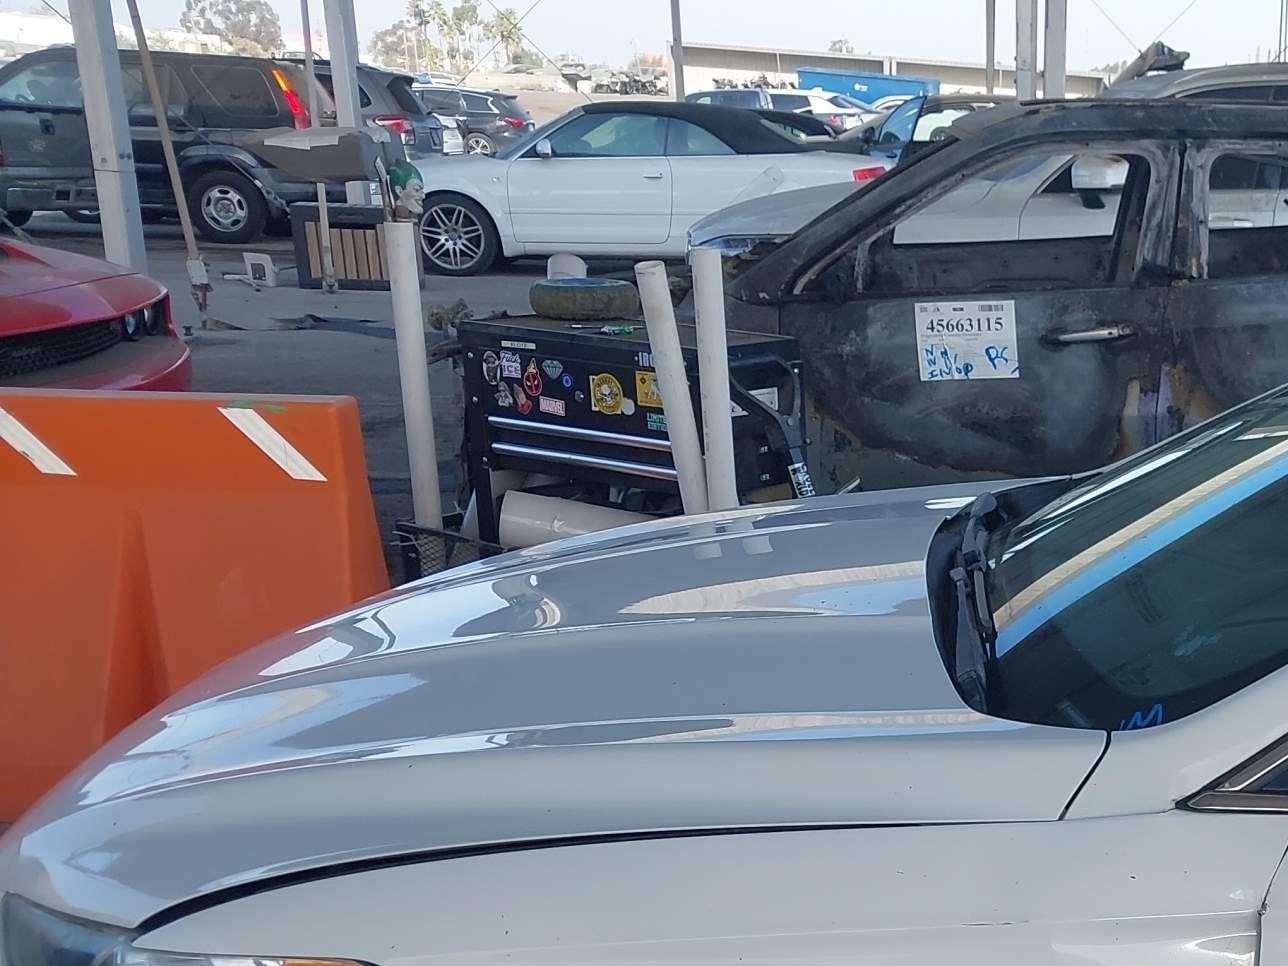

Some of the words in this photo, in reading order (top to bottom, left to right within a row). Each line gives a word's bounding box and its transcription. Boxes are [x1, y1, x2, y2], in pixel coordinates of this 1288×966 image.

[926, 316, 1004, 333] 45663115
[503, 364, 521, 376] ICE
[540, 396, 565, 416] MARVEL
